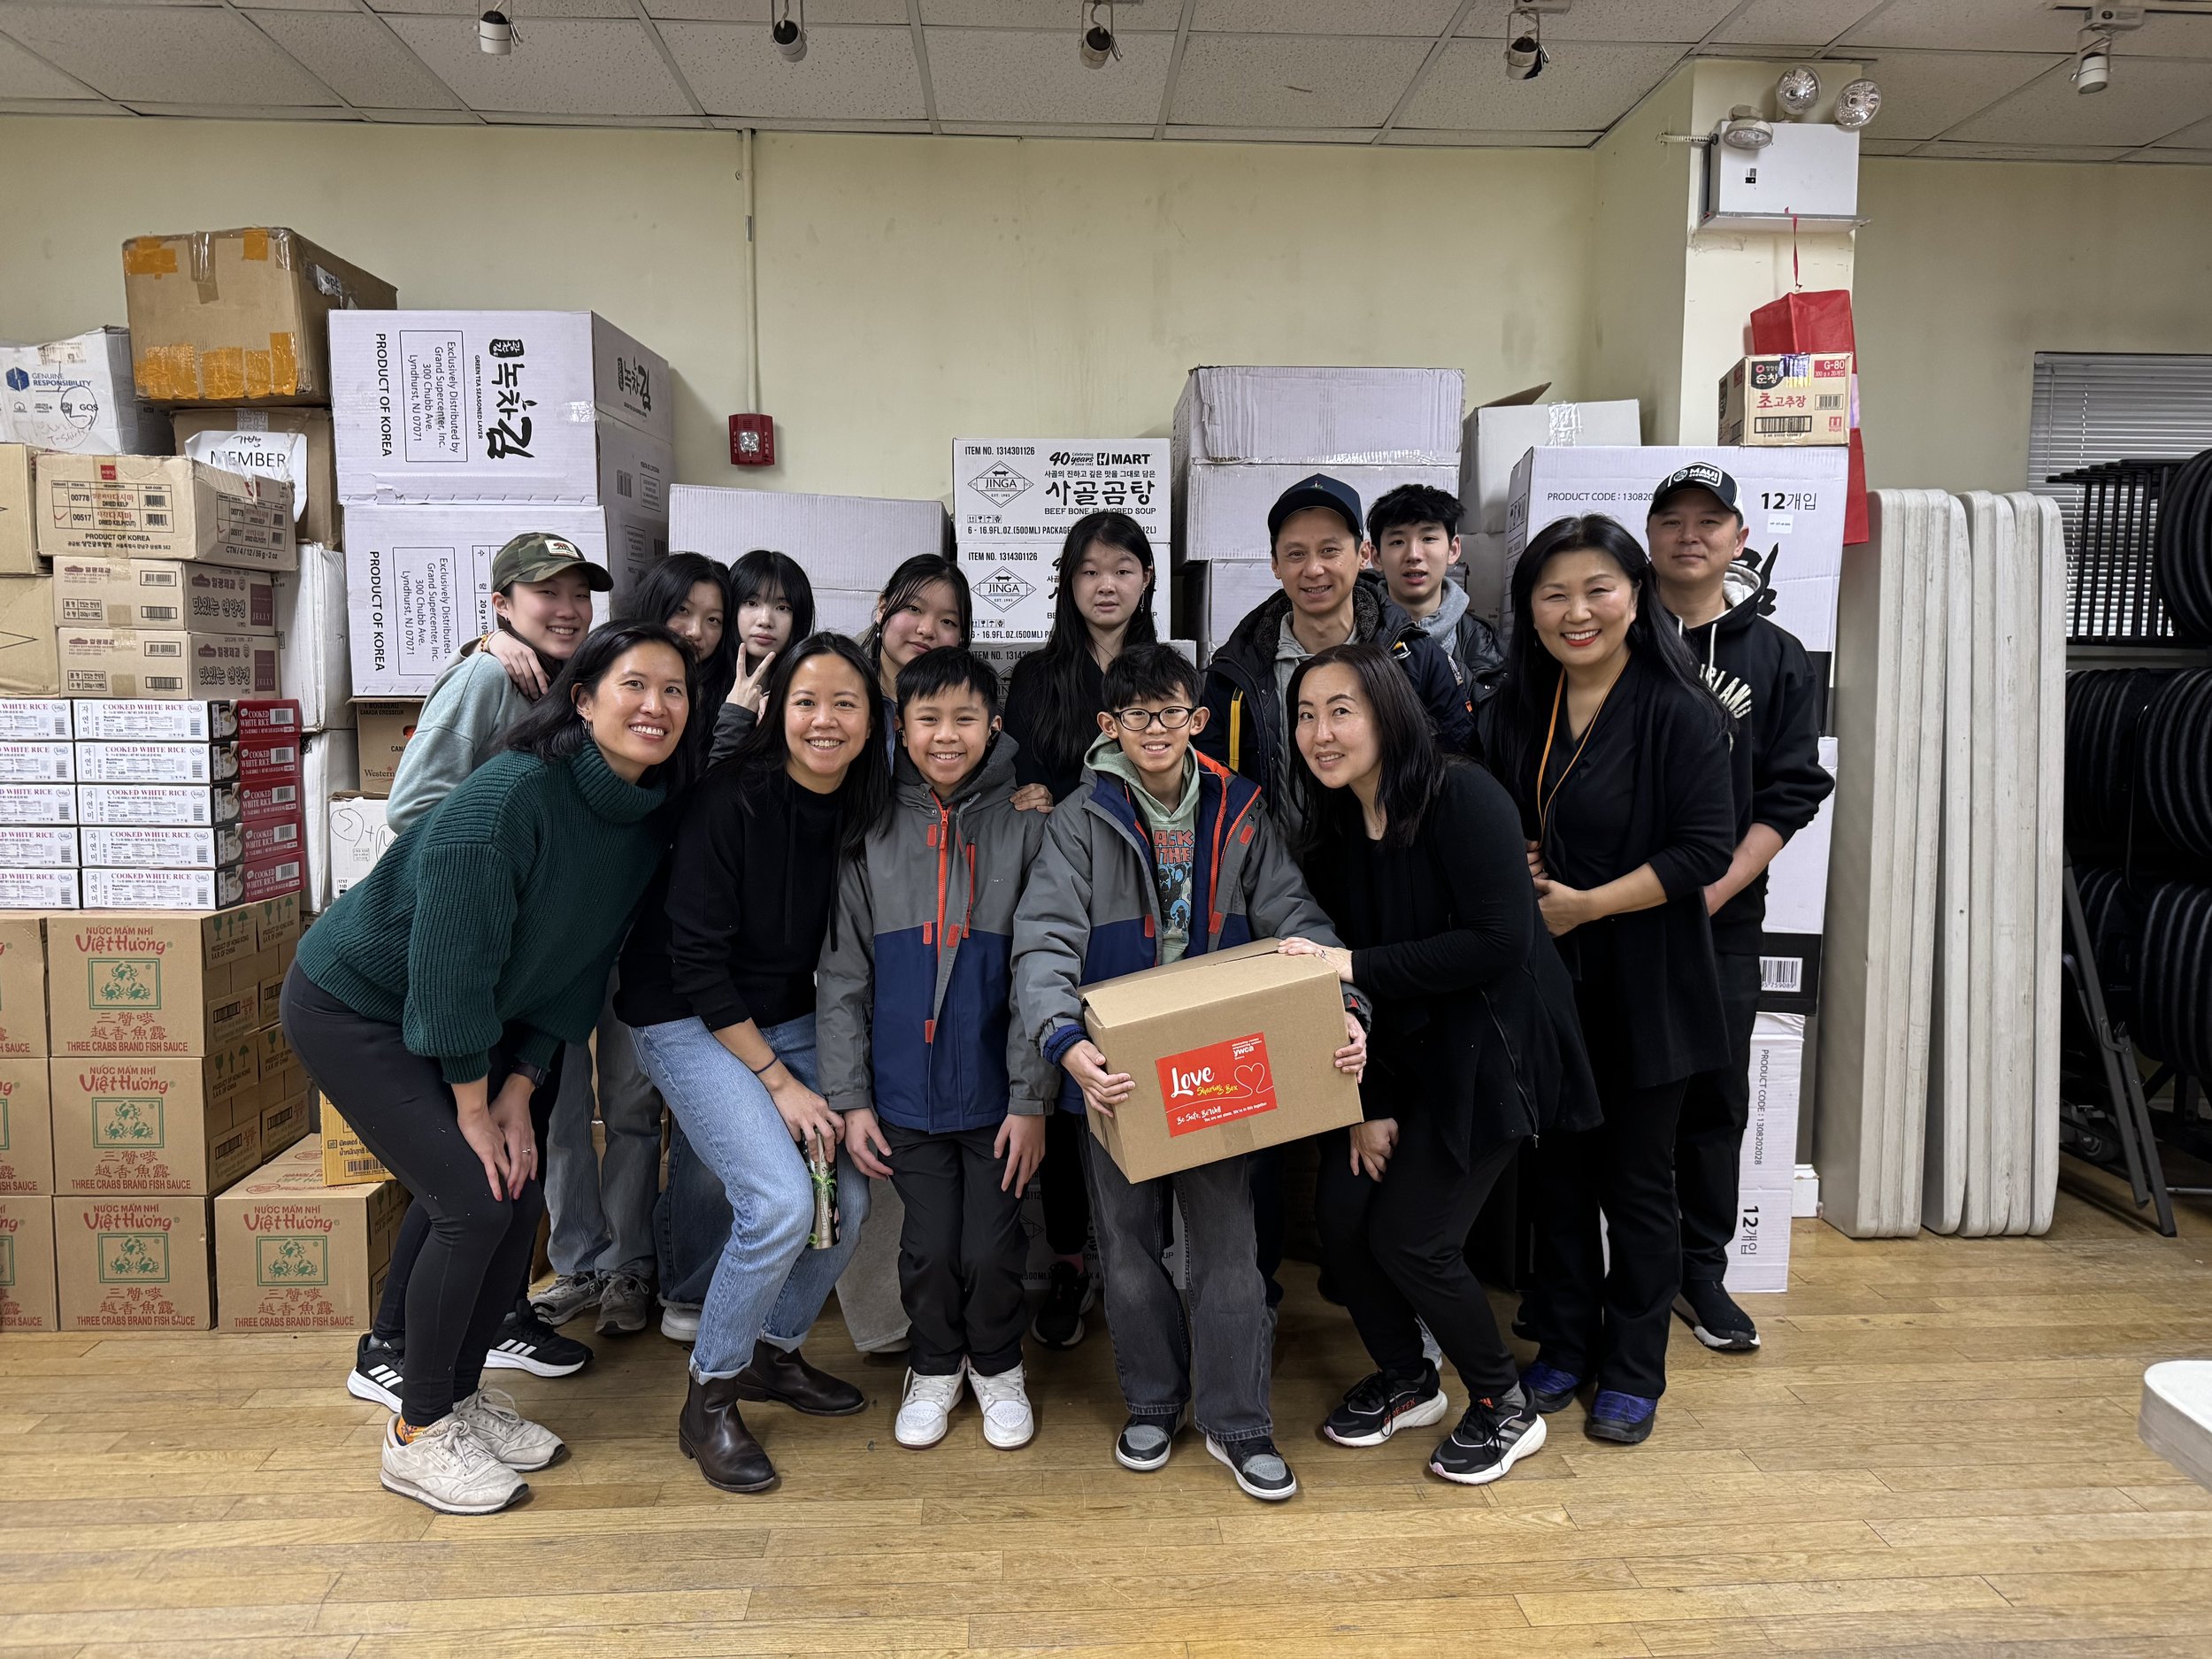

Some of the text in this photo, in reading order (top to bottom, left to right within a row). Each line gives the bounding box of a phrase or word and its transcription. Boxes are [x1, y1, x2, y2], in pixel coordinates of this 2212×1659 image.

[434, 347, 444, 374] Grand
[1824, 360, 1845, 370] G-80
[408, 355, 419, 401] Lyndhurst,
[1755, 373, 1778, 384] 순창
[376, 334, 392, 457] PRODUCT OF KOREA
[424, 381, 434, 411] Chubb
[447, 342, 460, 453] Exclusively Distributed by
[1756, 392, 1807, 409] 초고추장
[412, 403, 420, 415] NJ
[435, 377, 446, 430] Supercenter,
[425, 413, 434, 432] Ave.
[964, 446, 1035, 456] ITEM NO. 1314301126
[1048, 451, 1094, 466] 40 years
[1111, 454, 1151, 465] MART
[1689, 467, 1719, 478] MAUI
[986, 479, 1018, 488] JINGA
[71, 494, 89, 503] 00778
[1046, 480, 1156, 506] 사골곰탕
[1761, 492, 1816, 511] 12개입
[968, 552, 1038, 561] ITEM NO. 1314301126
[427, 563, 437, 589] Grand
[988, 584, 1020, 593] JINGA
[192, 595, 246, 618] 맛있는 연양갱
[370, 551, 385, 672] PRODUCT OF KOREA
[440, 557, 452, 654] Exclusively Distributed
[427, 592, 438, 645] Supercenter,
[198, 666, 250, 685] 맛있는 연양갱
[256, 678, 273, 687] JELLY
[365, 769, 395, 778] Western
[1154, 829, 1194, 846] ACK
[255, 869, 275, 879] COOKED
[247, 877, 275, 889] WHITE RICE
[90, 1025, 168, 1041] 越香魚露
[66, 1041, 188, 1052] THREE CRABS BRAND FISH SAUCE
[1233, 1046, 1255, 1056] ywca
[1171, 1067, 1215, 1099] Love
[1196, 1084, 1240, 1096] Sharing Box
[1755, 1049, 1770, 1165] PRODUCT CODE 1308202028
[1177, 1117, 1186, 1125] Be
[1201, 1110, 1210, 1118] Be
[1209, 1106, 1221, 1116] Well
[94, 1164, 171, 1179] 越香魚露
[1741, 1205, 1759, 1255] 12개입
[100, 1301, 176, 1315] 越香魚露
[257, 1301, 334, 1316] 越香魚露
[234, 1316, 354, 1327] THREE CRABS BRAND FISH SAUCE
